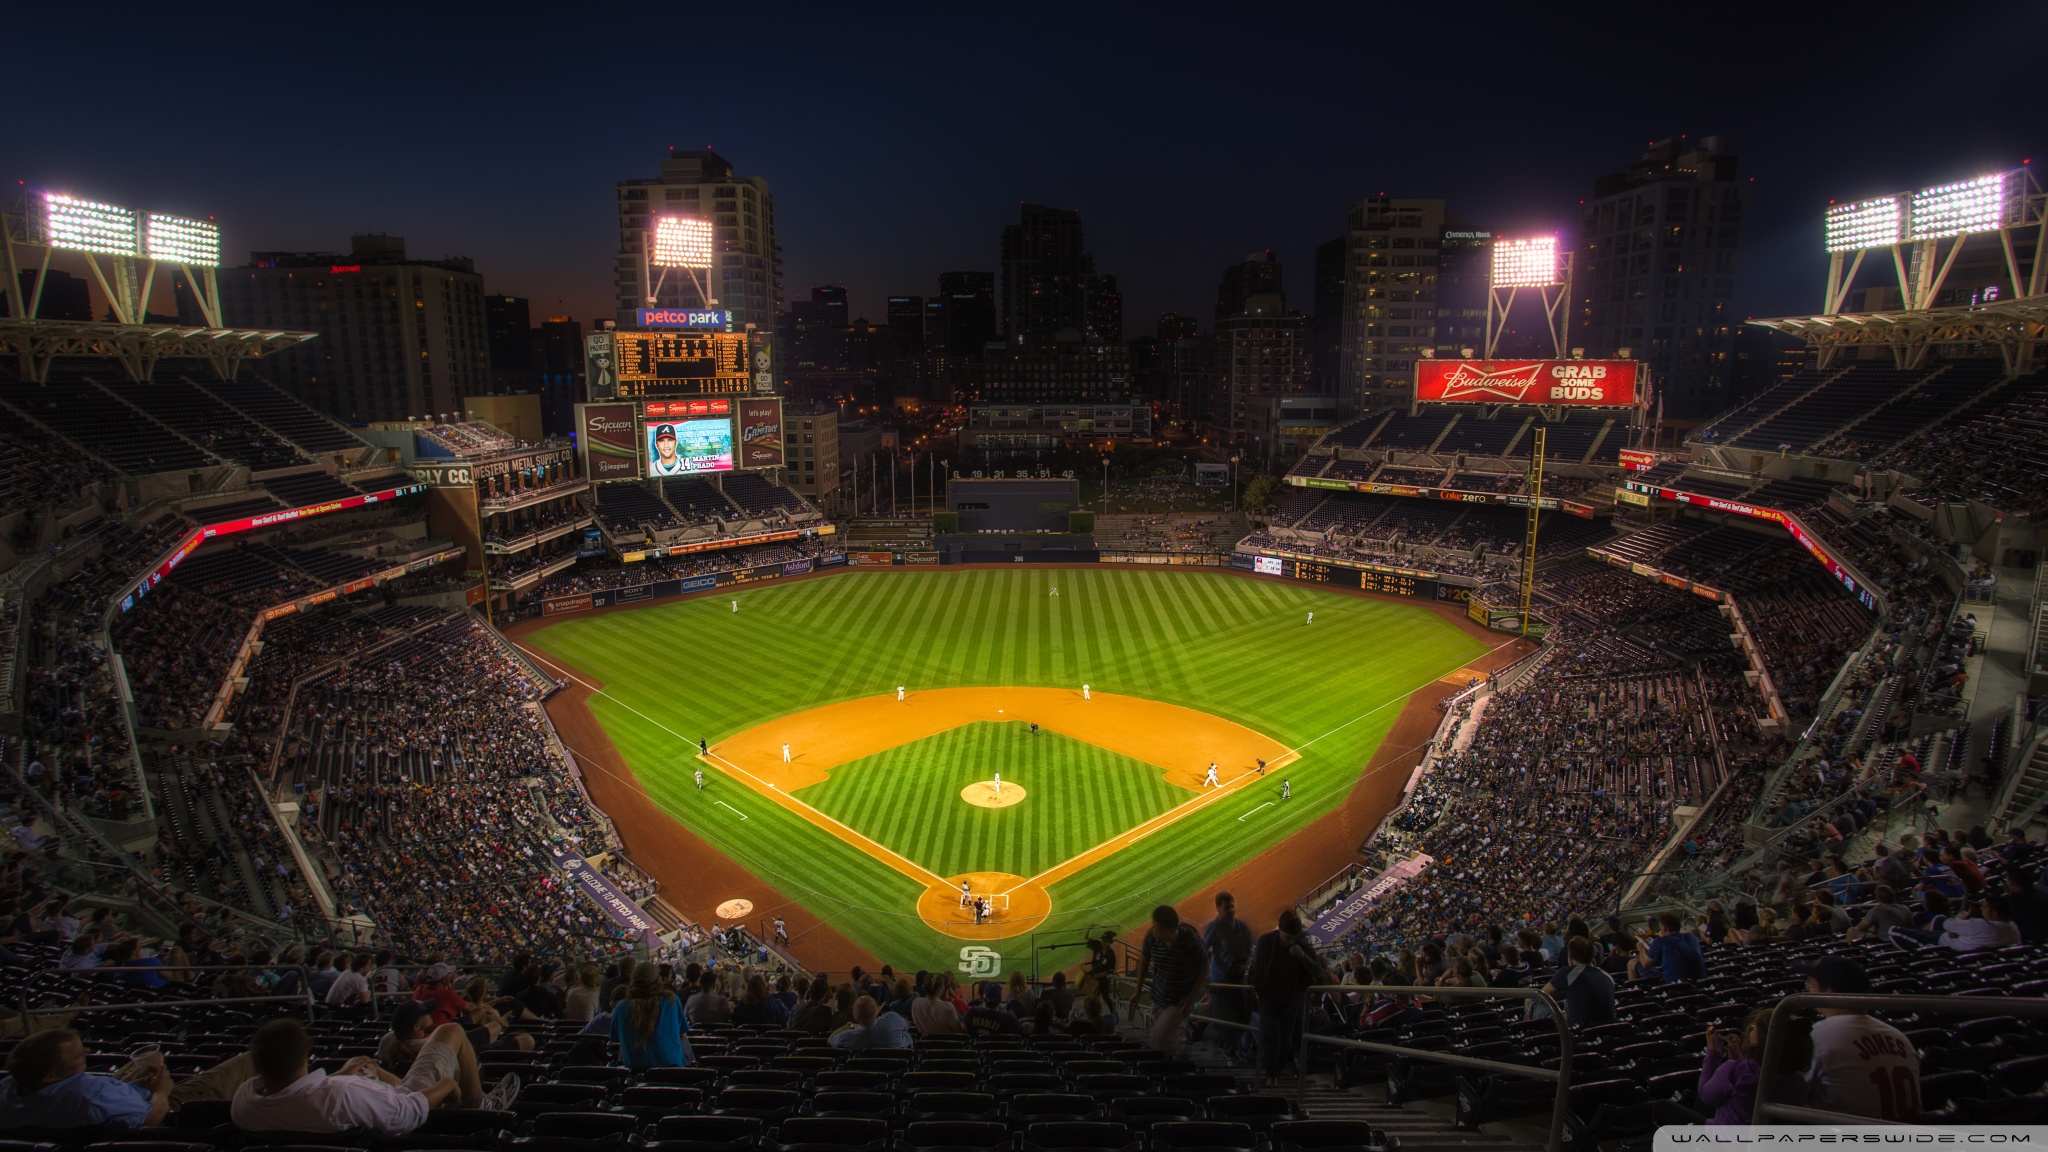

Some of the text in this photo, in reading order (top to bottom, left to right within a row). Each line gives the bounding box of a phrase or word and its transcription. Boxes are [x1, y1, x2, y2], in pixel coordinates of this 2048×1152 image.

[331, 265, 360, 273] Marriott
[646, 310, 719, 326] petco park
[593, 336, 604, 344] GO
[1551, 366, 1606, 379] GRAB
[1444, 372, 1536, 388] Budweiser
[1560, 379, 1596, 387] SOME
[1550, 387, 1603, 400] BUDS
[669, 404, 687, 412] Sycuan
[690, 403, 708, 412] Sycuan
[760, 409, 772, 417] play!
[589, 417, 632, 433] Sycuan
[752, 451, 772, 460] Sycuan
[474, 449, 572, 479] WESTERN METAL SUPPLY CO.
[680, 457, 691, 471] 14
[448, 469, 473, 484] CO.
[1440, 490, 1486, 502] Coke zero
[909, 554, 935, 564] Sycuan
[785, 562, 810, 571] Ashford
[683, 577, 715, 588] GEICO
[316, 592, 336, 601] TOYOTA
[623, 587, 643, 595] SONY
[1699, 589, 1716, 598] TOYOTA
[555, 596, 591, 607] snapdragon
[595, 599, 605, 607] 357
[274, 604, 296, 616] TOYOTA
[578, 870, 650, 932] WELCOME TO PETCO PARK
[1321, 876, 1398, 932] SAN DIEGO PADRES
[958, 946, 1001, 978] SD
[1852, 1034, 1907, 1060] JONES
[1868, 1066, 1920, 1120] 10
